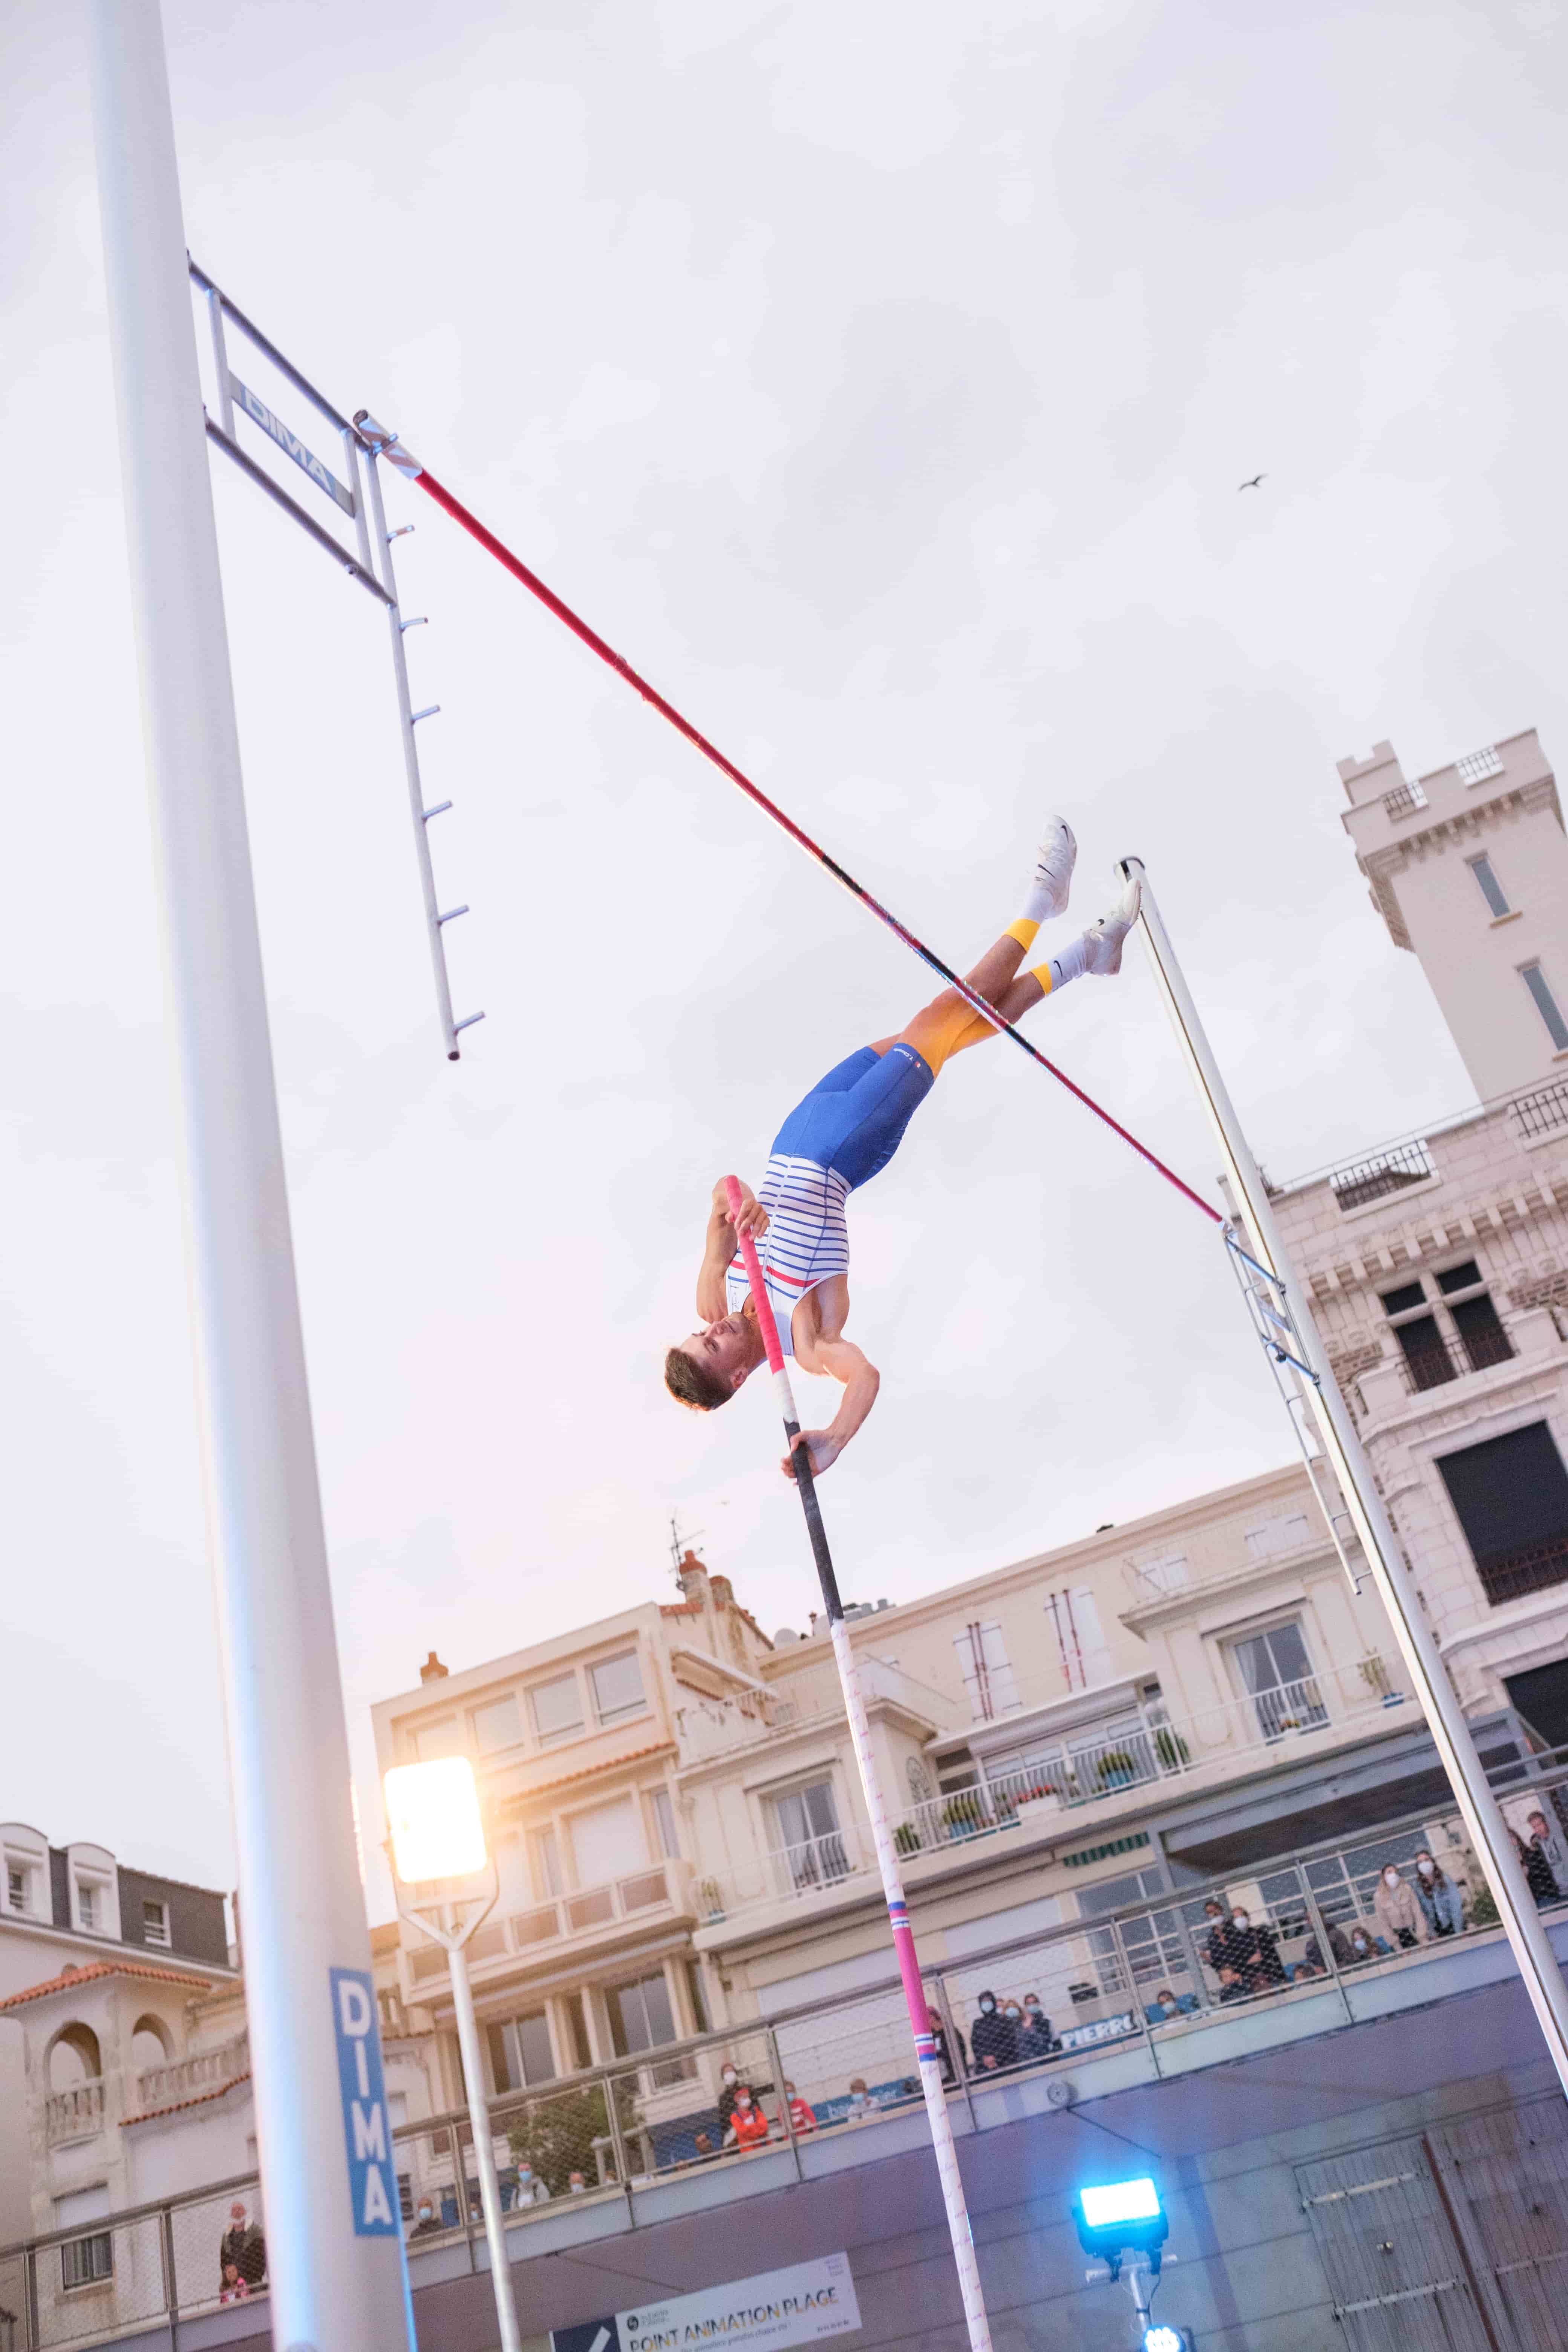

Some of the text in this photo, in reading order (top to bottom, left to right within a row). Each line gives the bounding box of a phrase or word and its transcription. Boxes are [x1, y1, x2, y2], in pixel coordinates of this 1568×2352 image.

[245, 387, 333, 496] DIMA
[339, 1980, 393, 2225] DIMA
[630, 2329, 679, 2352] POINT
[684, 2303, 780, 2342] ANIMATION
[783, 2286, 839, 2316] PLAGE
